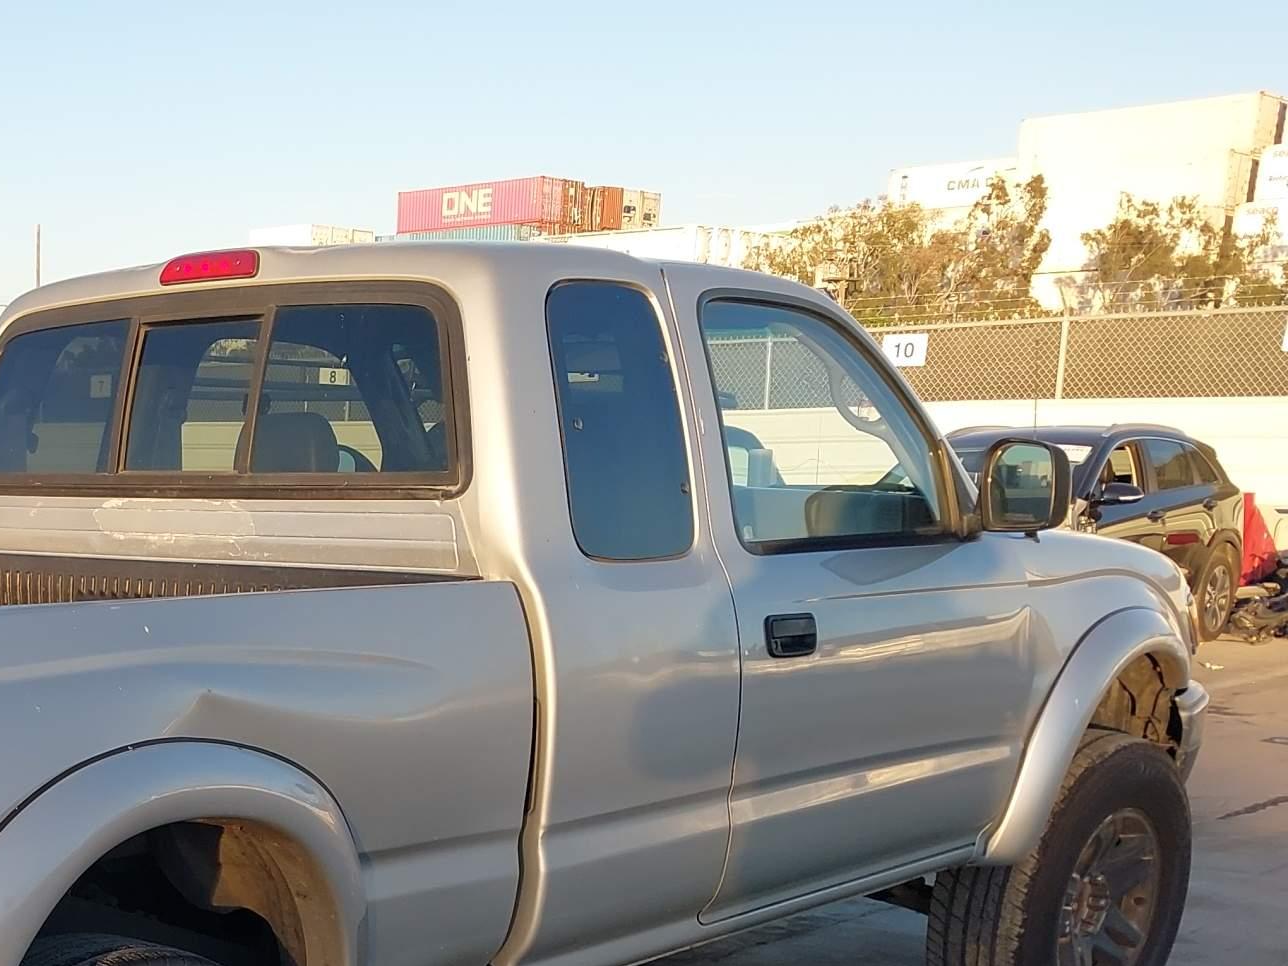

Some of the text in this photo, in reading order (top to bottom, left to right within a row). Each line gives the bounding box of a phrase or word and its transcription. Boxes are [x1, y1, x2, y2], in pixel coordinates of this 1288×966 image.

[946, 177, 981, 191] CMA
[441, 188, 493, 217] ONE
[894, 342, 915, 358] 10
[329, 370, 337, 384] 8
[97, 380, 105, 393] 7
